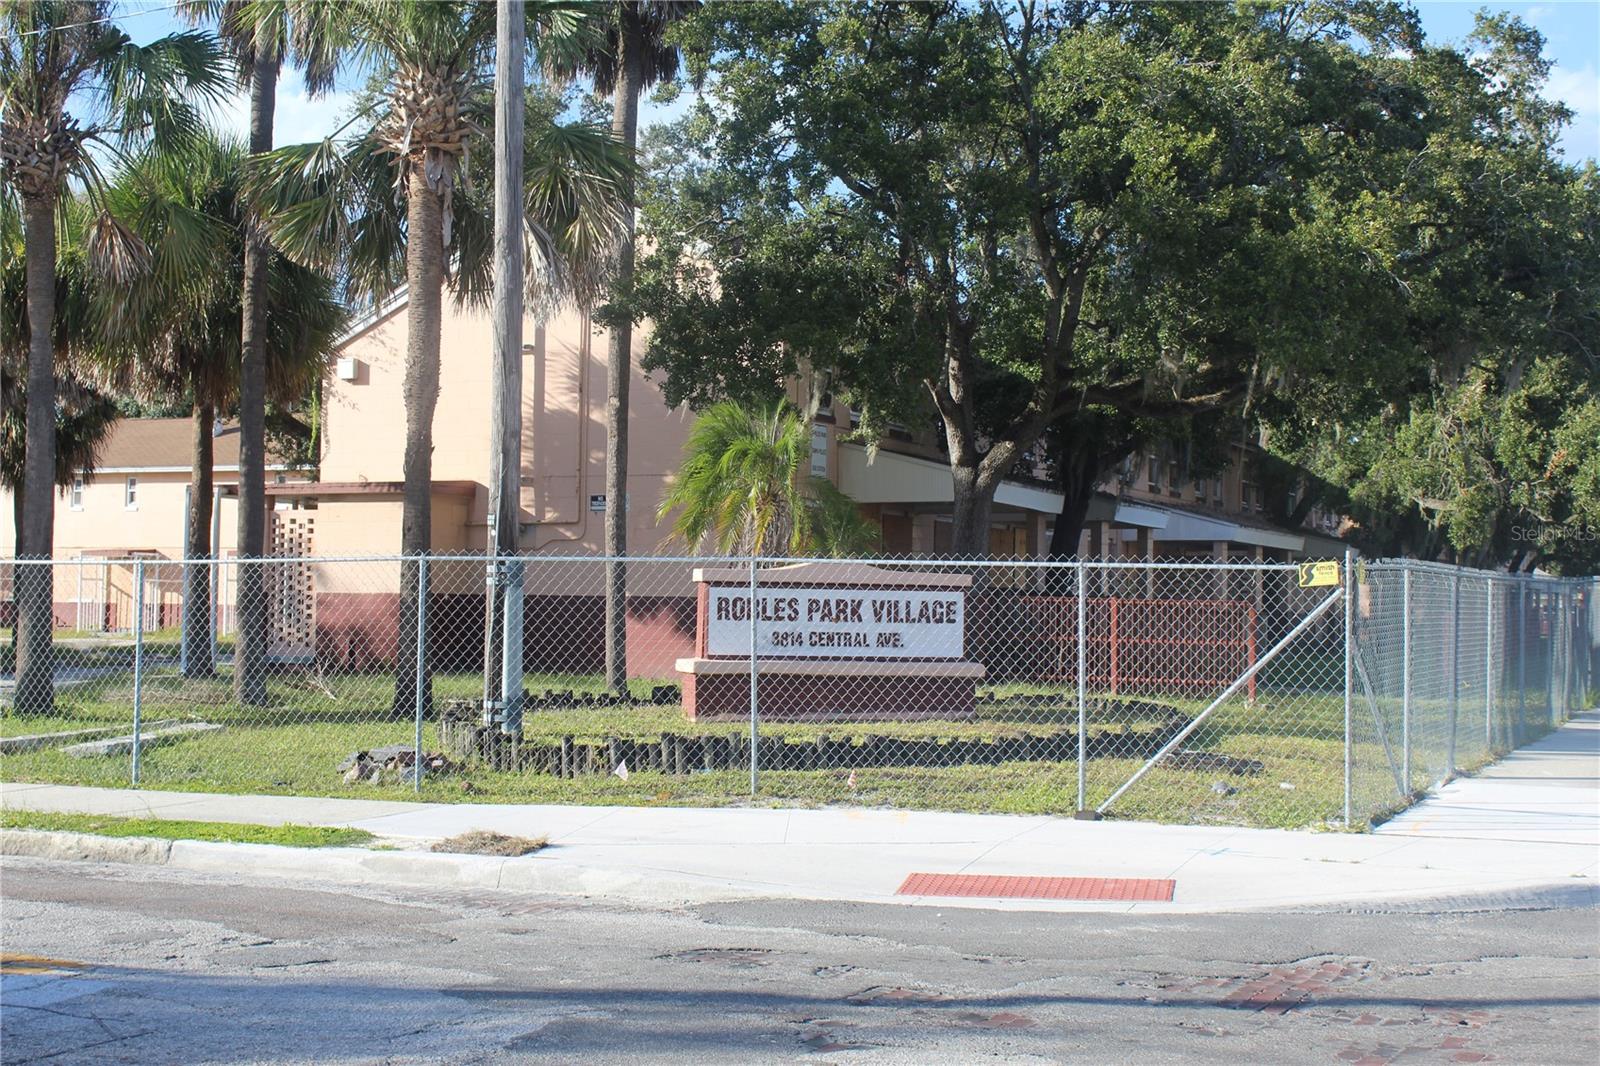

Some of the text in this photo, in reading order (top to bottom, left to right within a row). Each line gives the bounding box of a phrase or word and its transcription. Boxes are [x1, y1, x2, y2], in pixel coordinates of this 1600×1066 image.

[807, 598, 864, 622] PARK
[872, 600, 957, 623] VILLAGE
[771, 631, 904, 648] 3814 CENTRAL AVE.
